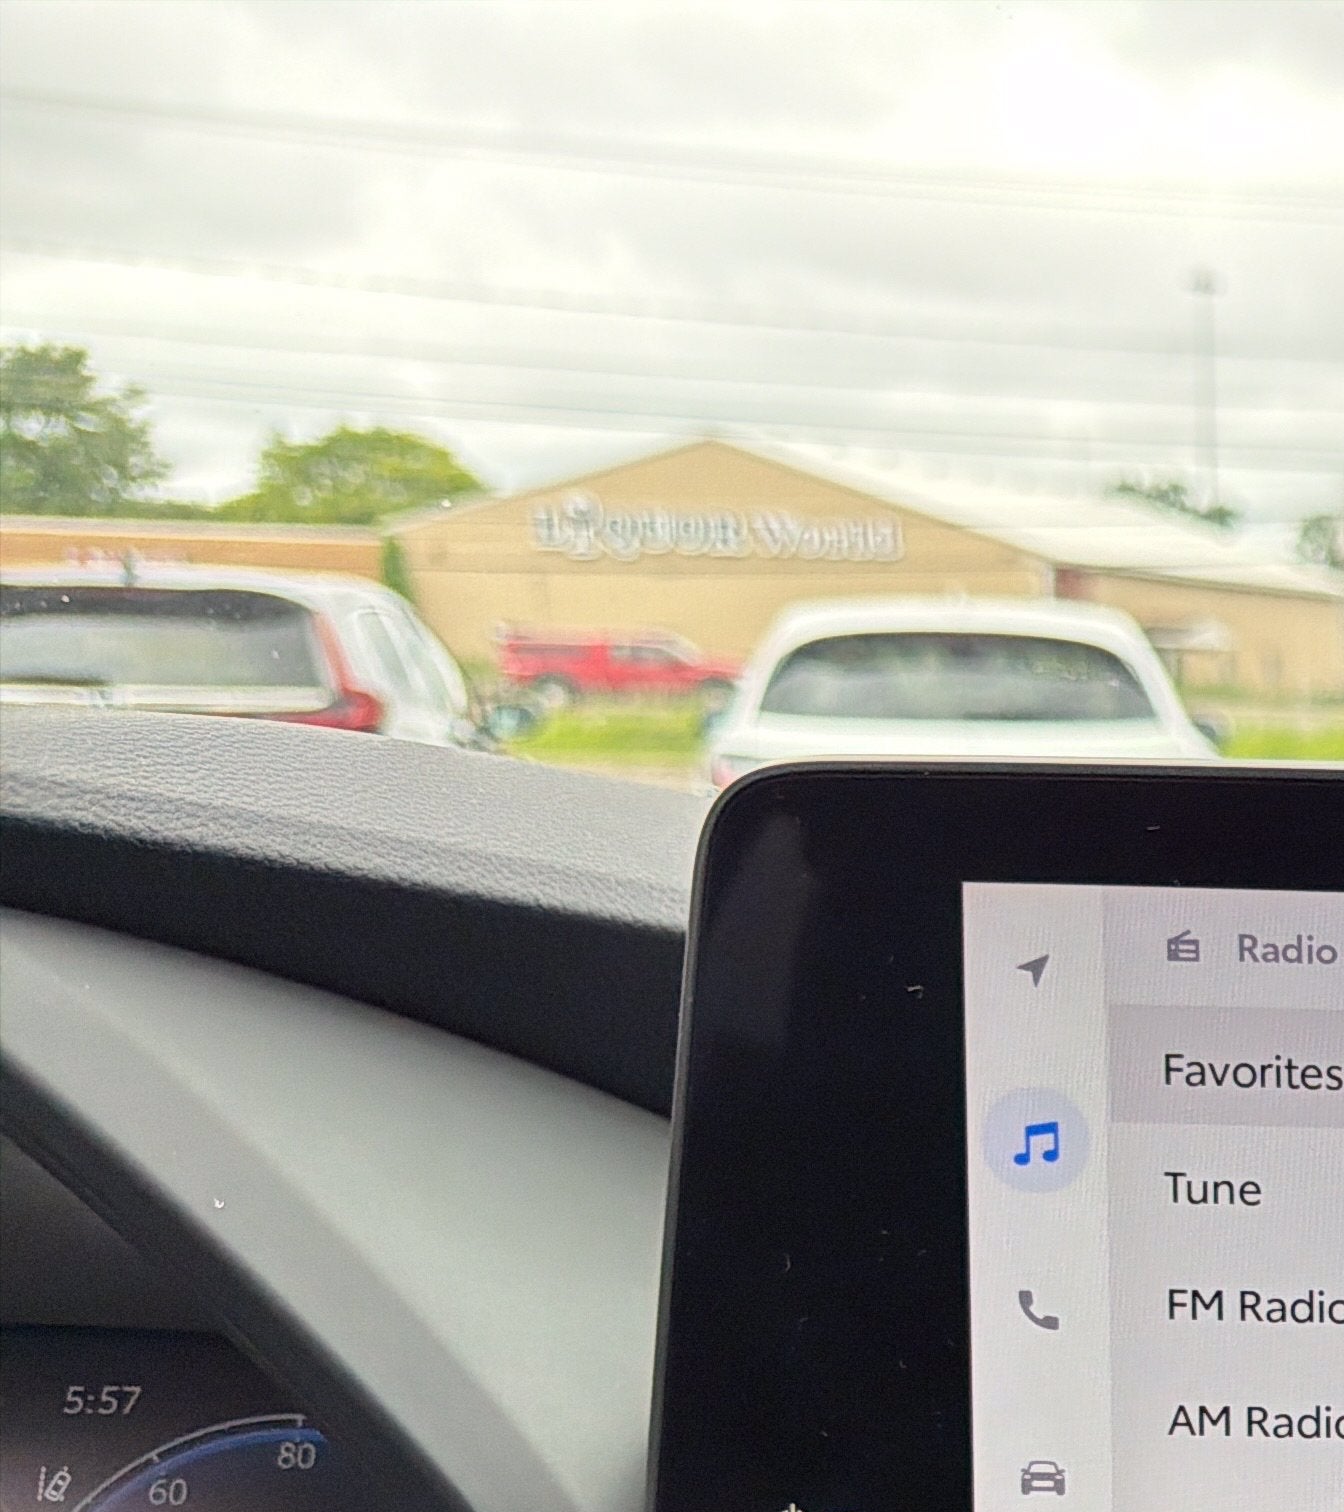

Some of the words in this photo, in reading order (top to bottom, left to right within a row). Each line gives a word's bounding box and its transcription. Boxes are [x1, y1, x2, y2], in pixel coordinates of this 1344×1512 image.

[1238, 934, 1337, 964] Radio
[1165, 1054, 1343, 1090] Favorites
[1164, 1172, 1261, 1206] Tune
[1169, 1289, 1223, 1320] FM
[64, 1386, 141, 1414] 5:57
[1169, 1405, 1230, 1436] AM
[275, 1440, 317, 1472] 80
[146, 1477, 188, 1508] 60
